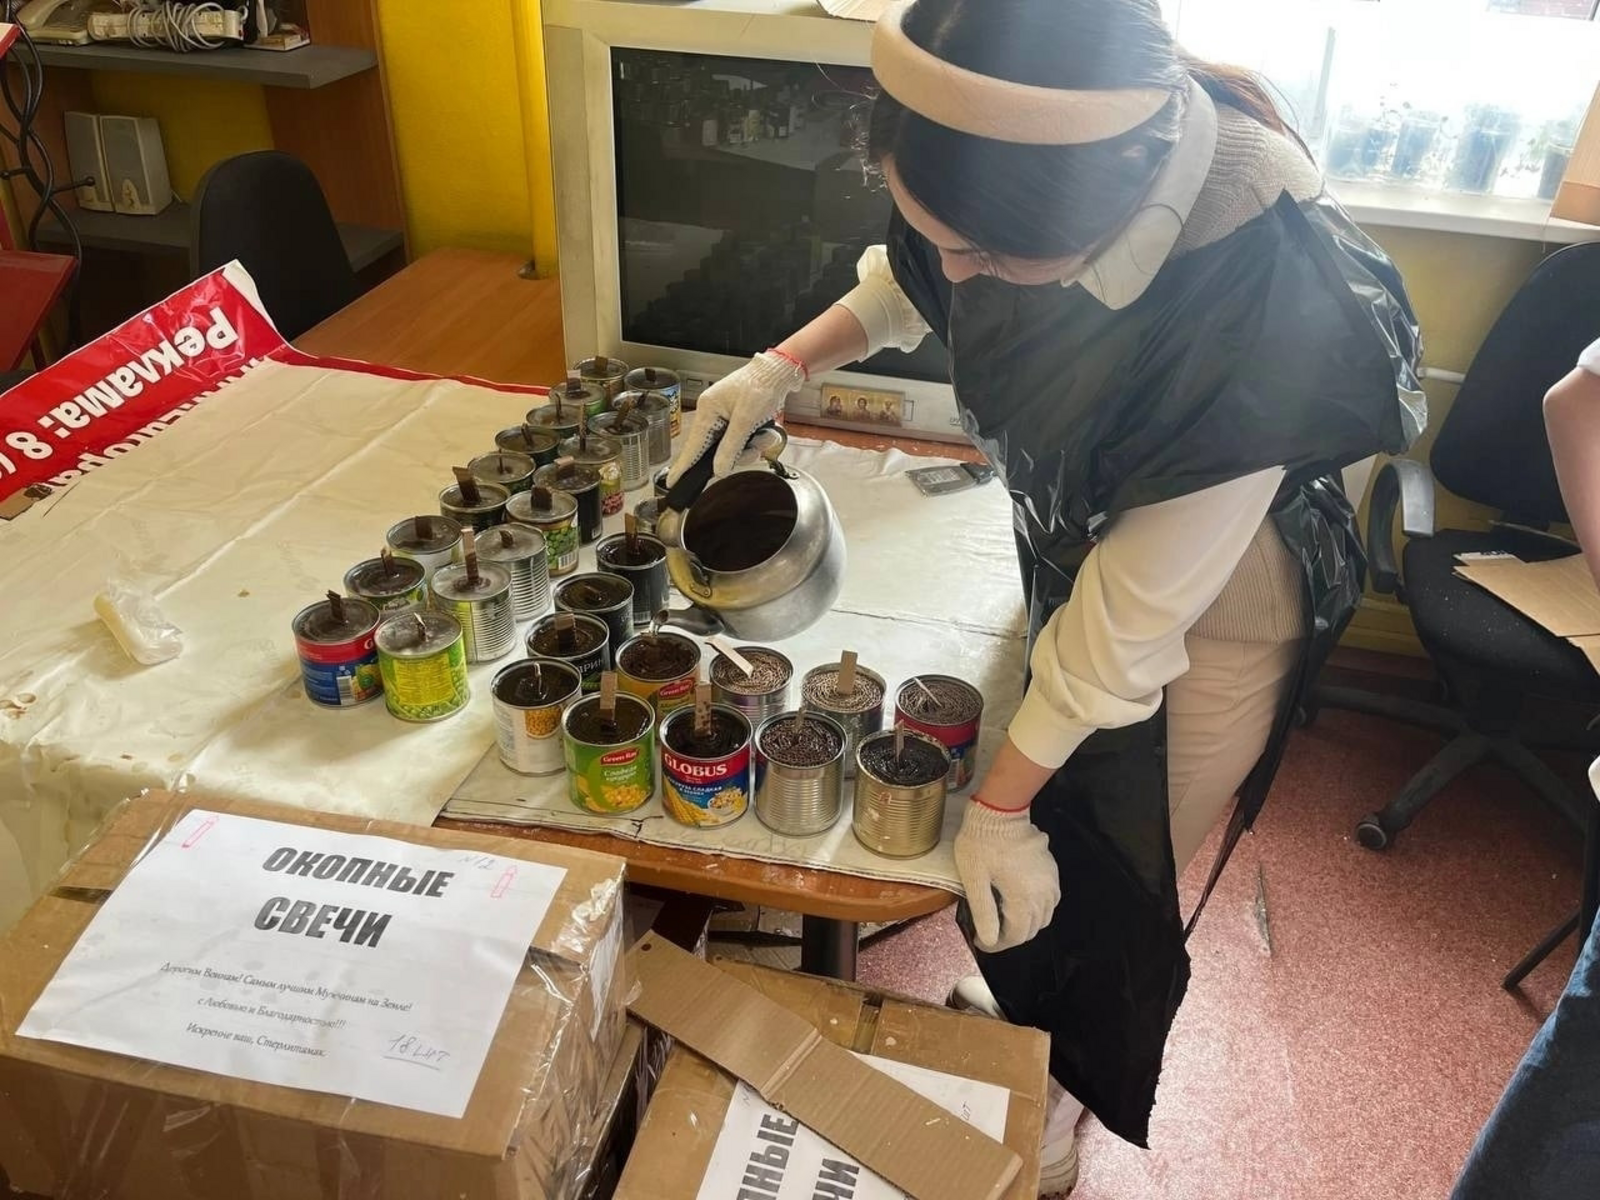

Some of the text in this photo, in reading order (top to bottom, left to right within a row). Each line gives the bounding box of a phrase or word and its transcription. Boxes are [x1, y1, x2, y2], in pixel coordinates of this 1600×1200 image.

[37, 307, 239, 438] Реклама:
[5, 431, 54, 460] 8
[664, 753, 728, 777] GLOBUS
[262, 846, 455, 898] ОКОПНЫЕ
[253, 896, 392, 948] СВЕЧИ
[160, 962, 202, 976] Дорогим
[203, 967, 244, 982] Воинам!
[243, 975, 276, 988] Самым
[367, 997, 380, 1007] на
[380, 998, 413, 1012] Земле!
